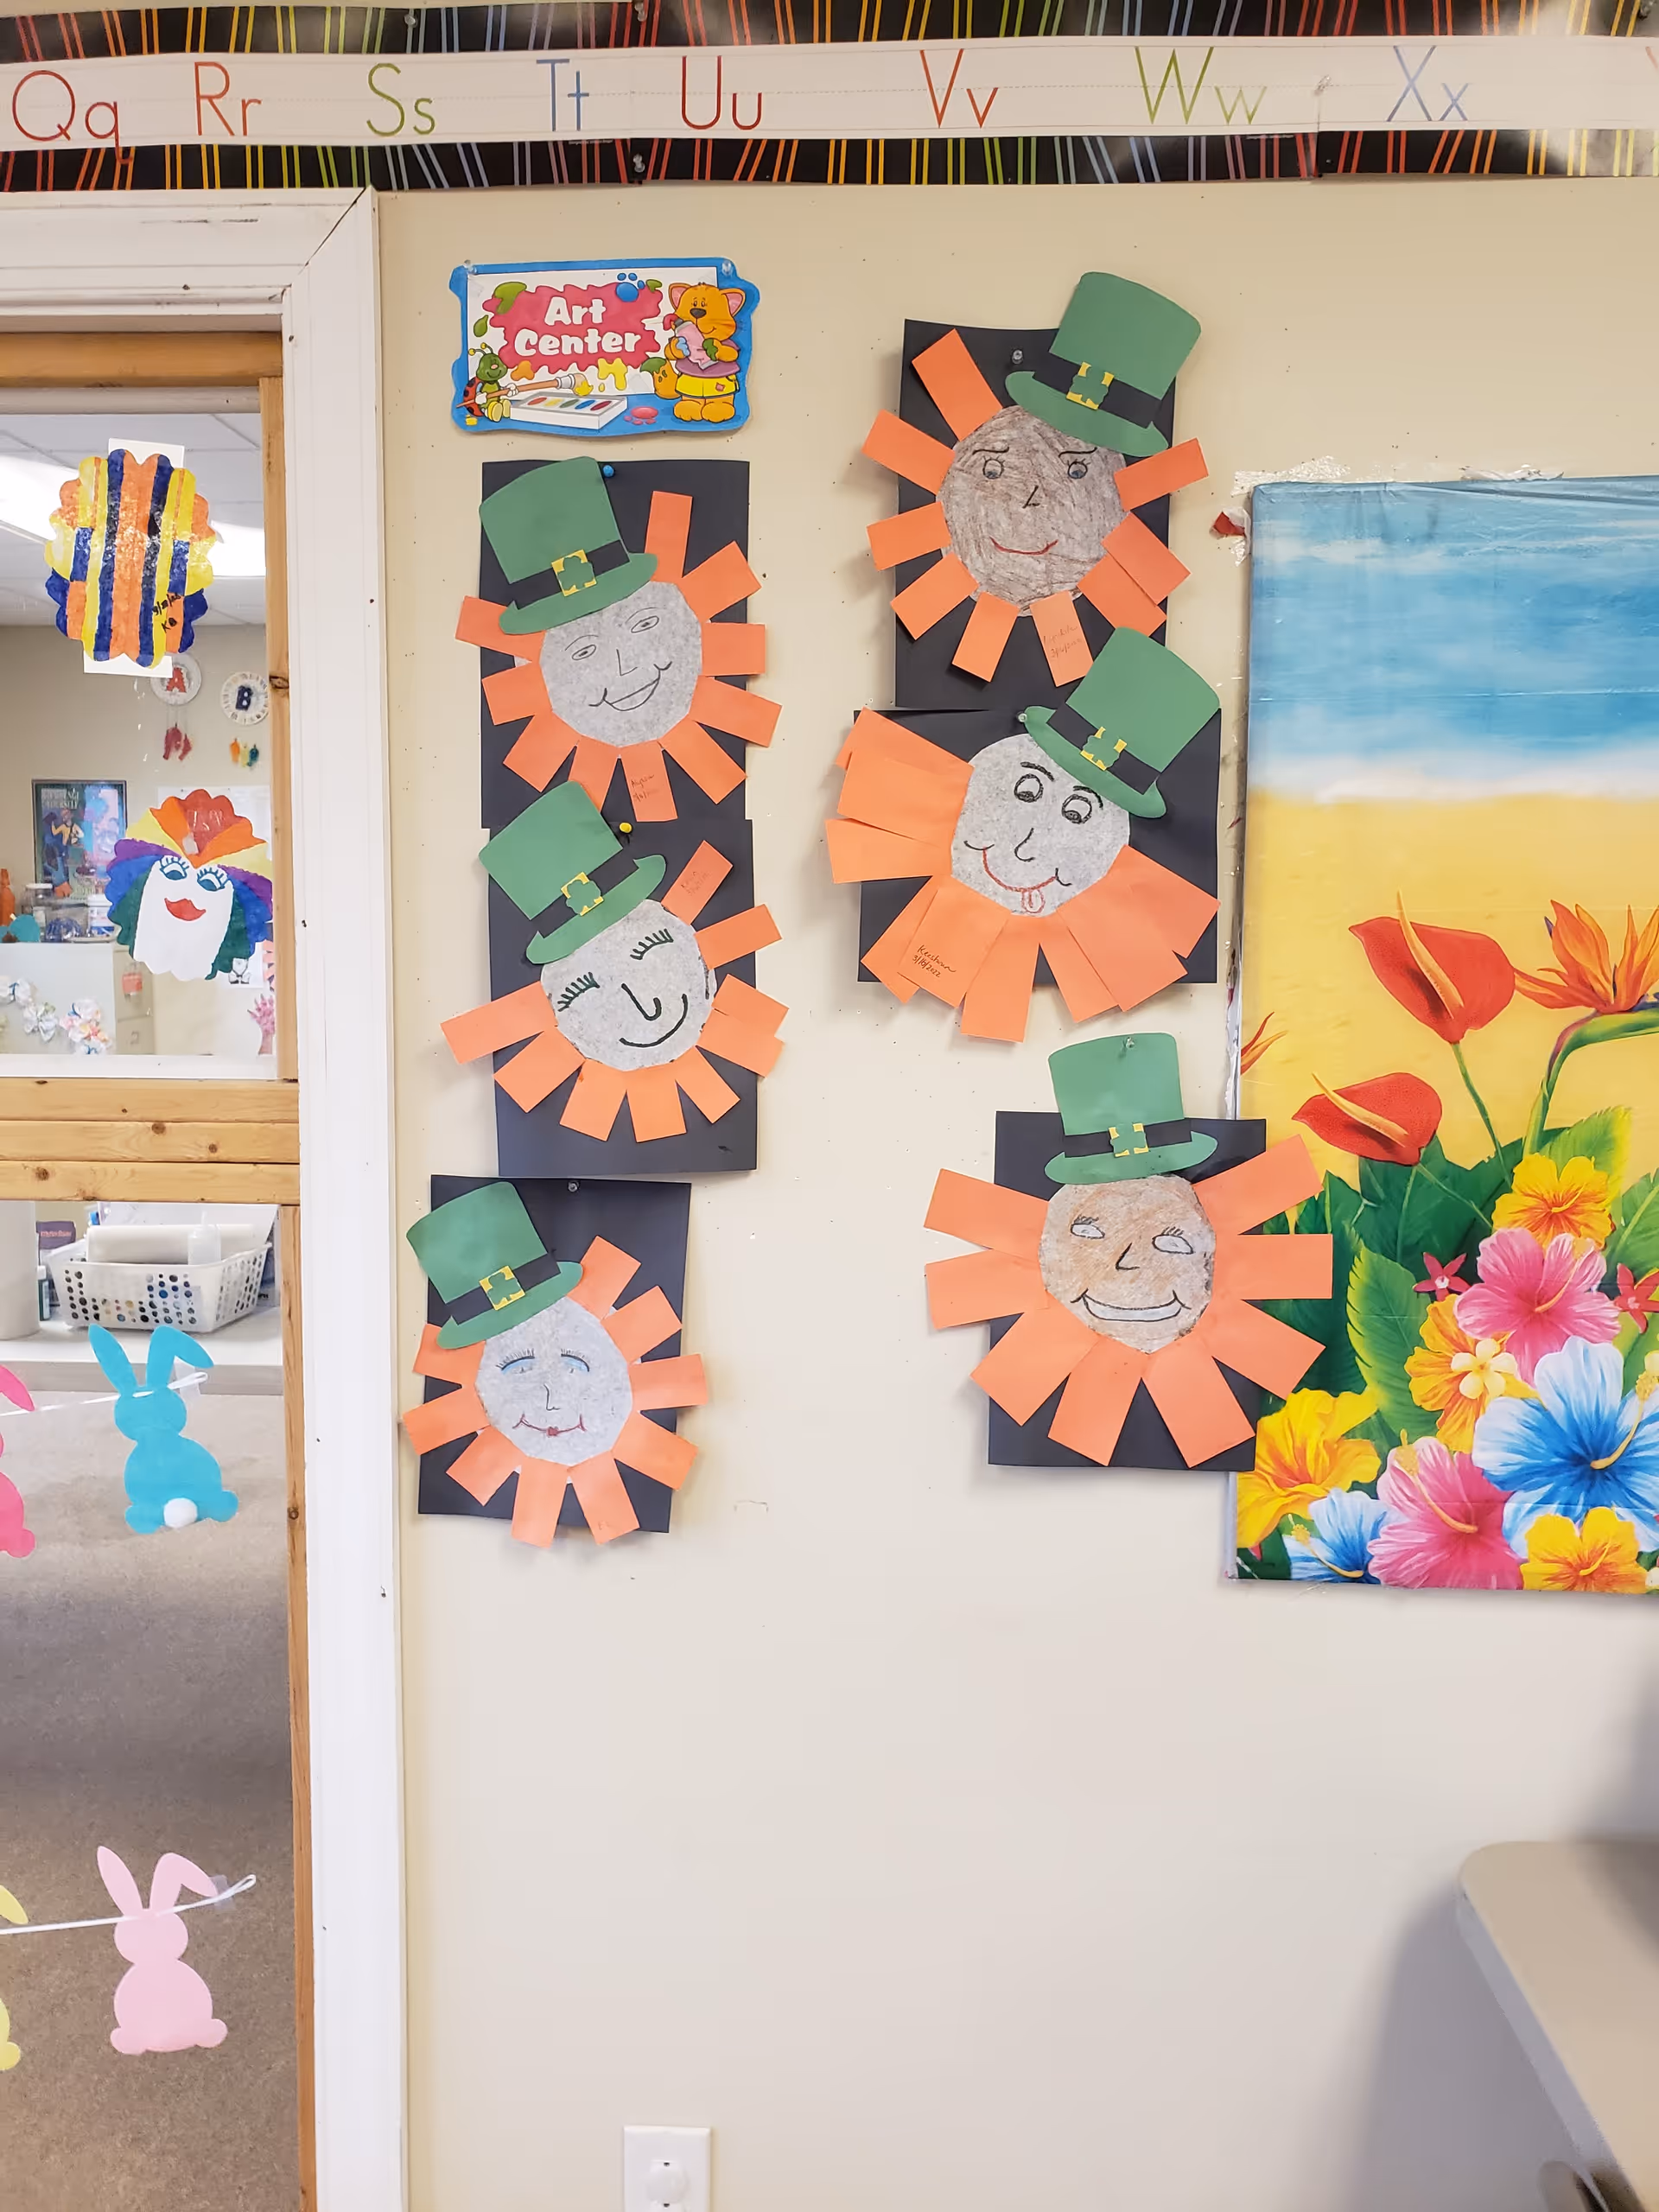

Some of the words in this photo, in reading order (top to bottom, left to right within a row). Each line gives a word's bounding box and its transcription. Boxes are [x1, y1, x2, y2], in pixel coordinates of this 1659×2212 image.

[11, 69, 134, 164] Qq
[194, 61, 263, 137] Rr
[367, 63, 436, 137] Ss
[536, 59, 590, 132] Tt
[682, 55, 763, 130] Uu
[919, 48, 999, 128] Vv
[1135, 47, 1268, 125] Ww
[1388, 45, 1471, 123] Xx
[544, 296, 607, 326] Art
[514, 327, 642, 356] Center
[166, 666, 188, 694] A
[235, 684, 254, 712] B
[912, 954, 941, 978] 3/16/2022
